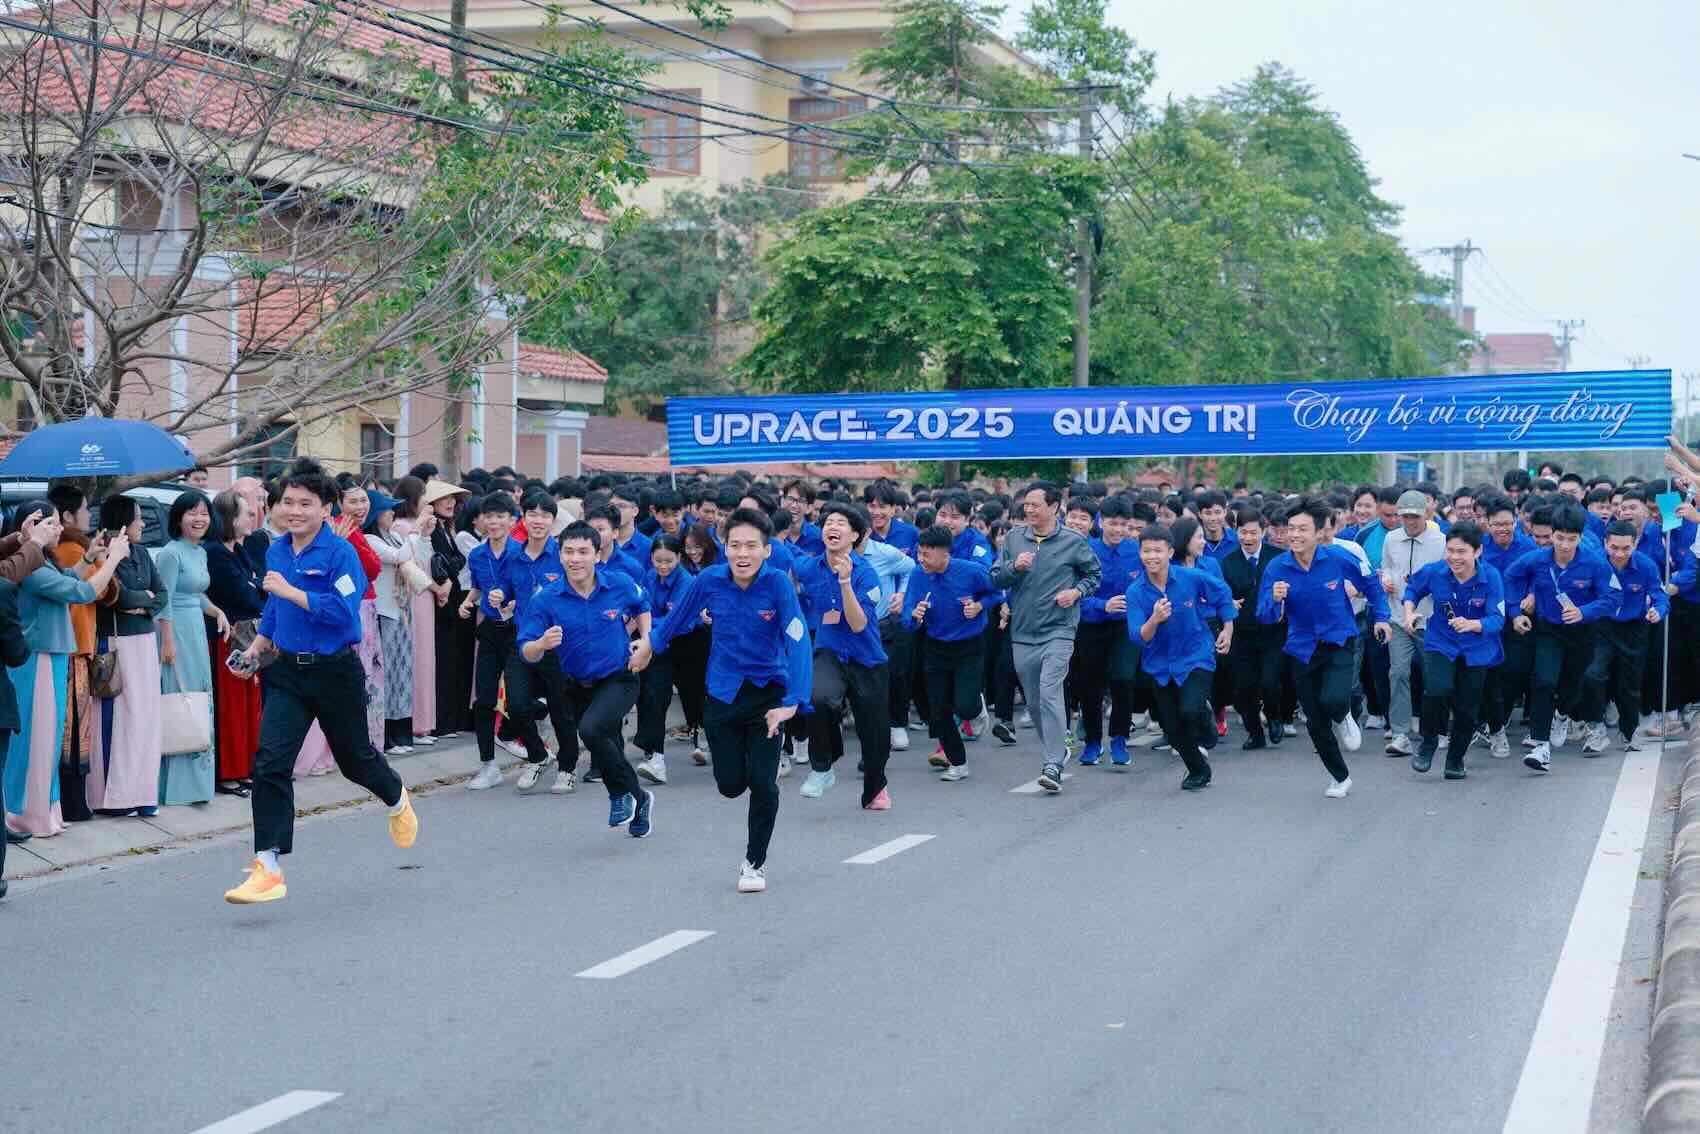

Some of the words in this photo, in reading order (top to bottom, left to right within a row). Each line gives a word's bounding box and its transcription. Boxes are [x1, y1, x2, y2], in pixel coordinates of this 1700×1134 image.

[886, 407, 1014, 440] 2025
[1052, 400, 1193, 436] QUẢNG
[1203, 404, 1257, 441] TRỊ
[1286, 388, 1381, 445] Chạy
[1387, 393, 1424, 431] bộ
[1428, 394, 1457, 425] vì
[1465, 395, 1542, 441] cộng
[1551, 386, 1634, 440] đồng
